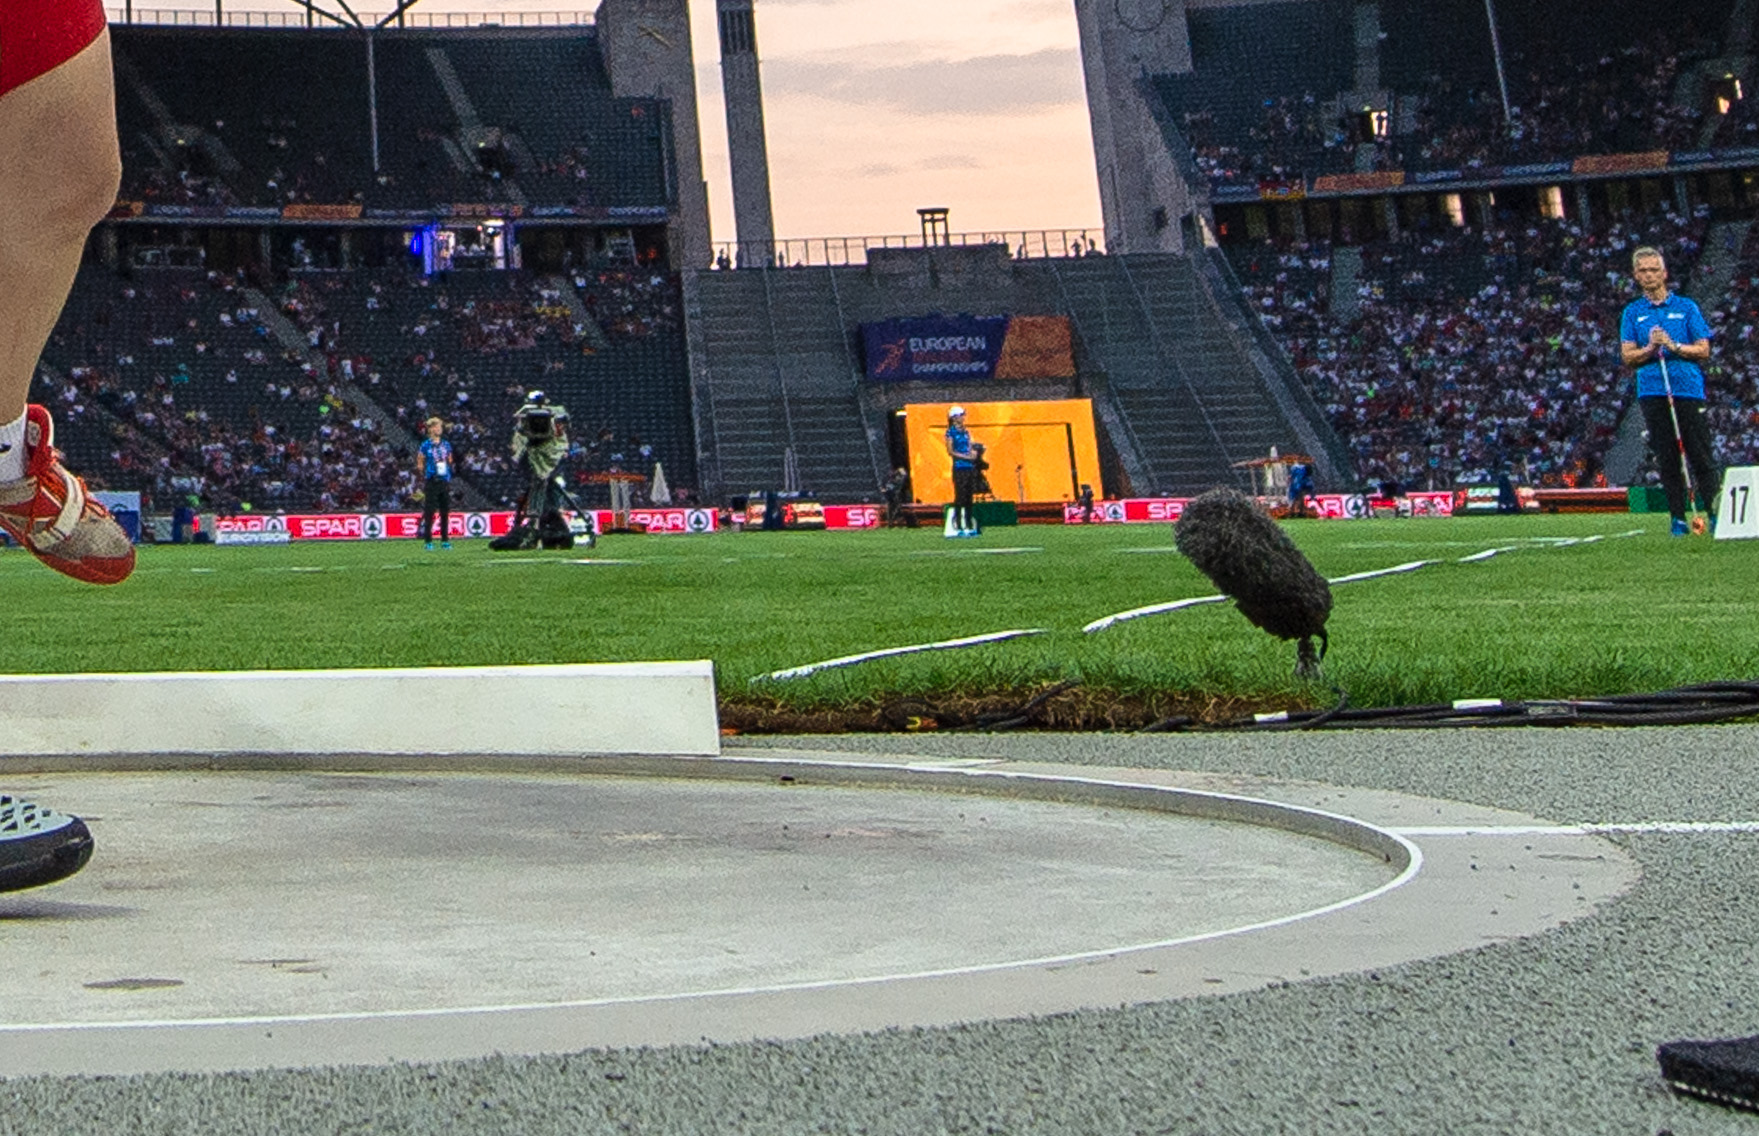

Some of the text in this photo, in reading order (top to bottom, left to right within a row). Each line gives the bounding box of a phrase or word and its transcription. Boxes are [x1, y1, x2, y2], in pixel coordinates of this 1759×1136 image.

[909, 335, 987, 352] EUROPEAN
[1729, 485, 1749, 525] 17
[301, 518, 361, 537] SPAR
